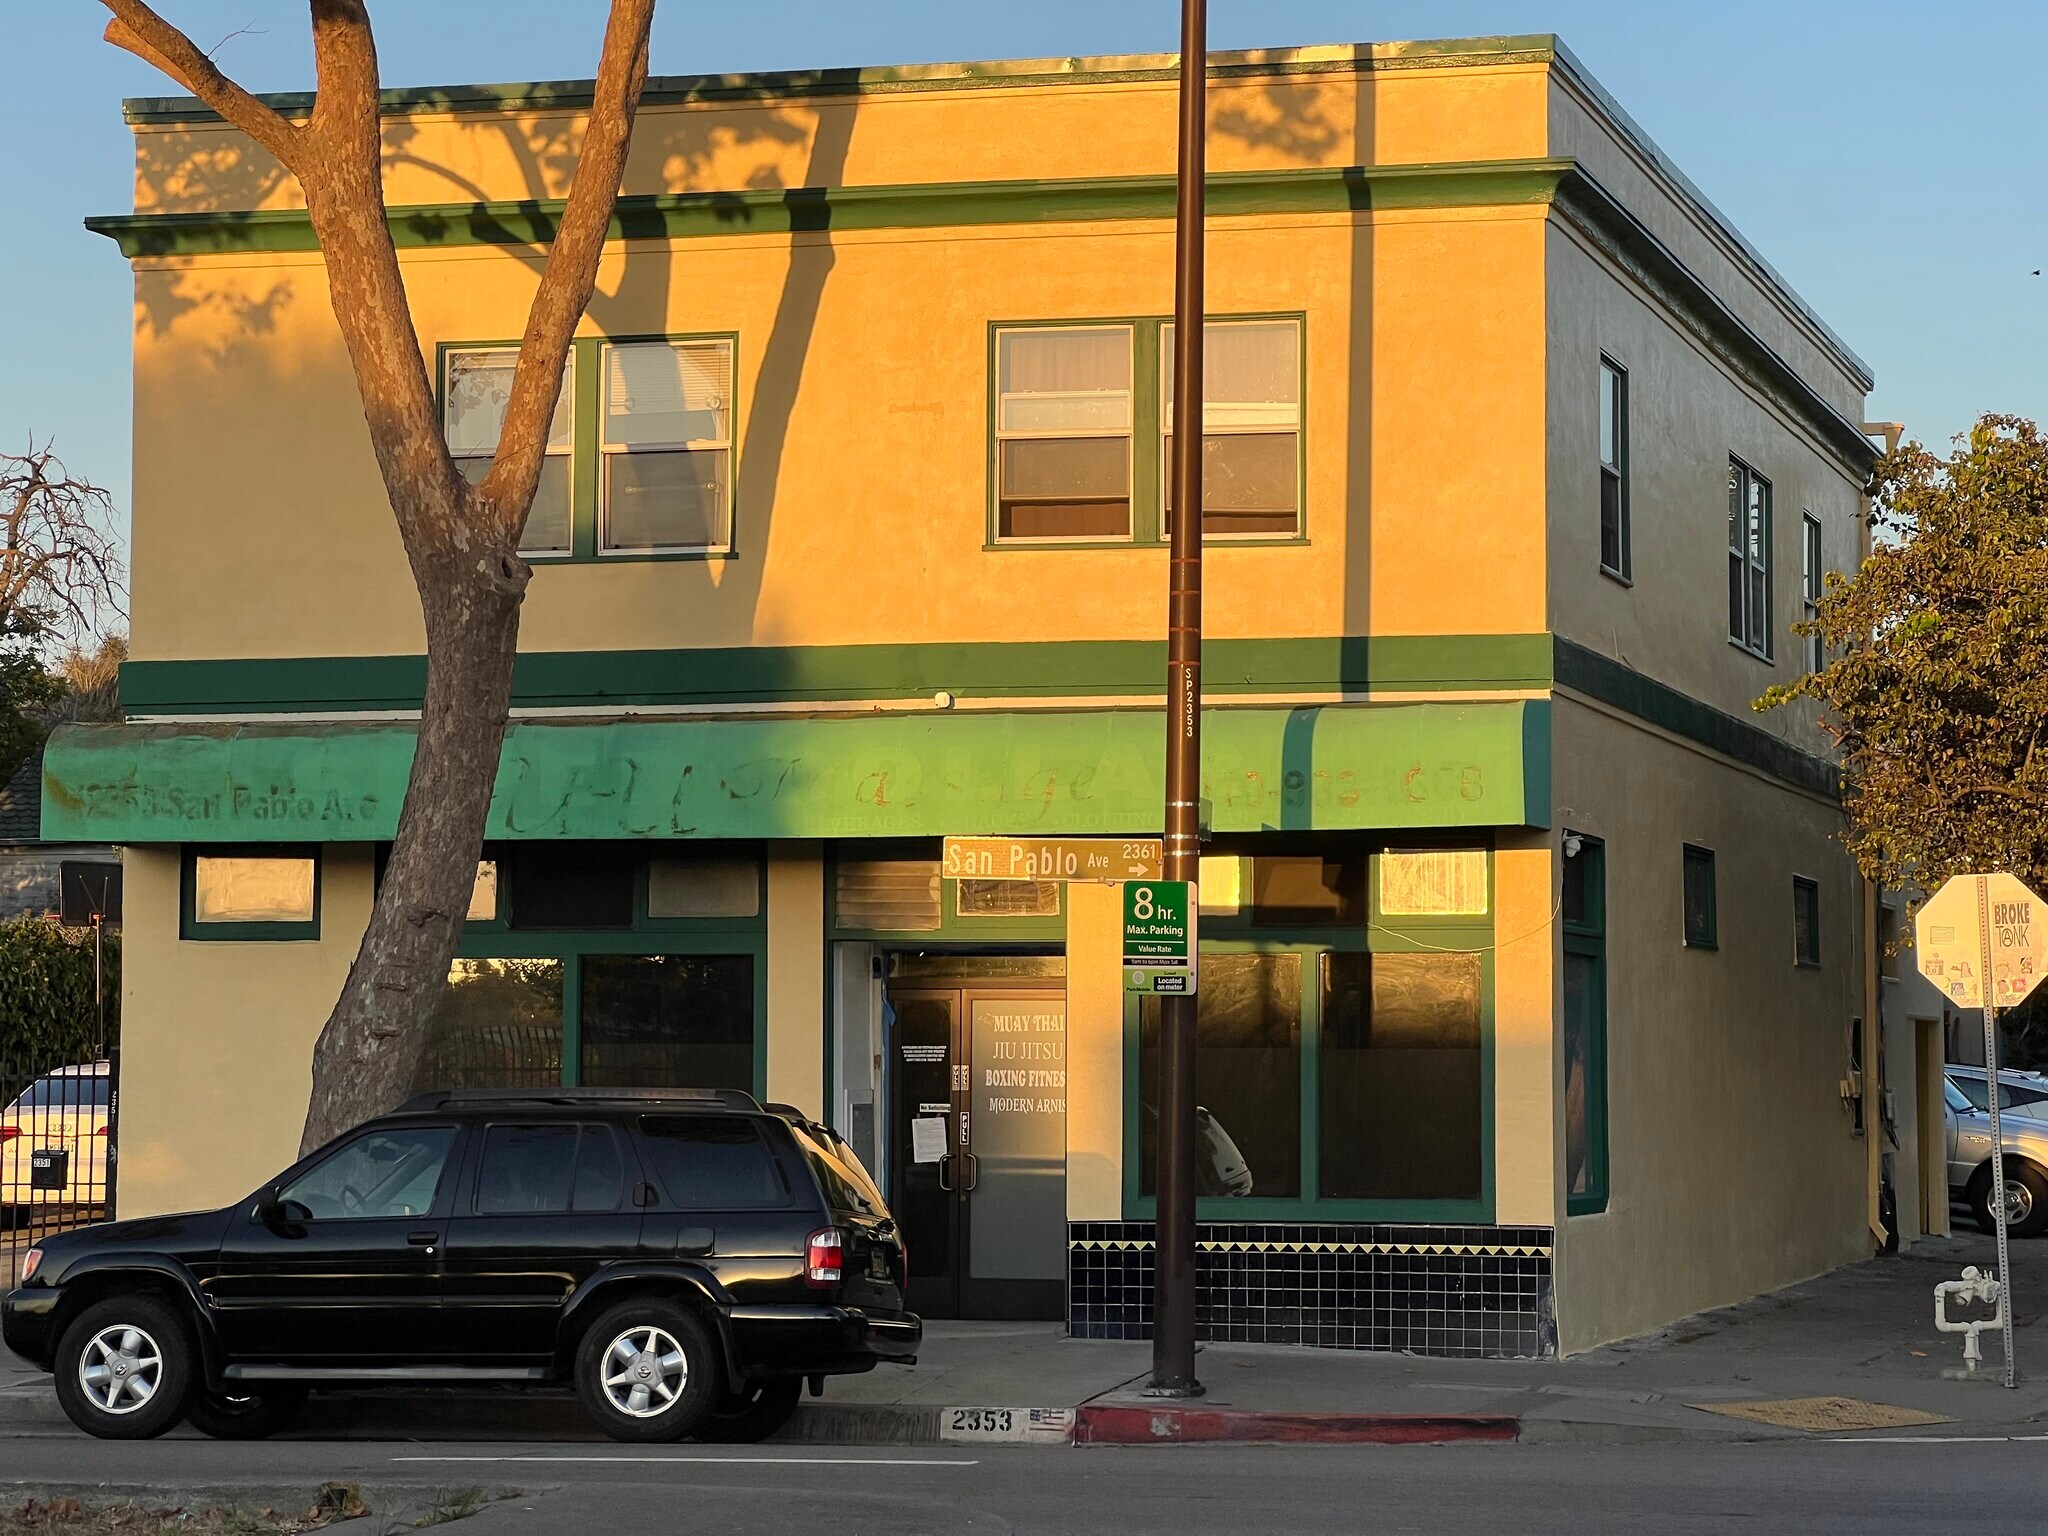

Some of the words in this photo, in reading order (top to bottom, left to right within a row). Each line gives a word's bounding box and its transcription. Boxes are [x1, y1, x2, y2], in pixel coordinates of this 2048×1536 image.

[1185, 668, 1193, 737] SP2353
[949, 844, 993, 874] San
[1009, 845, 1078, 875] Pablo
[1087, 852, 1109, 868] Ave
[1122, 844, 1156, 859] 2361
[1134, 887, 1154, 920] 8
[1158, 904, 1177, 920] hr.
[1994, 903, 2030, 924] BROKE
[1127, 924, 1148, 934] Max.
[1150, 924, 1183, 937] Parking
[1138, 945, 1157, 953] Value
[1157, 945, 1172, 953] Rate
[994, 1015, 1031, 1032] MUAY
[1033, 1014, 1065, 1032] THAI
[993, 1041, 1016, 1059] JIU
[1020, 1041, 1063, 1060] JITSU
[985, 1069, 1027, 1087] BOXING
[989, 1098, 1034, 1115] MODERN
[952, 1410, 1013, 1432] 2353
